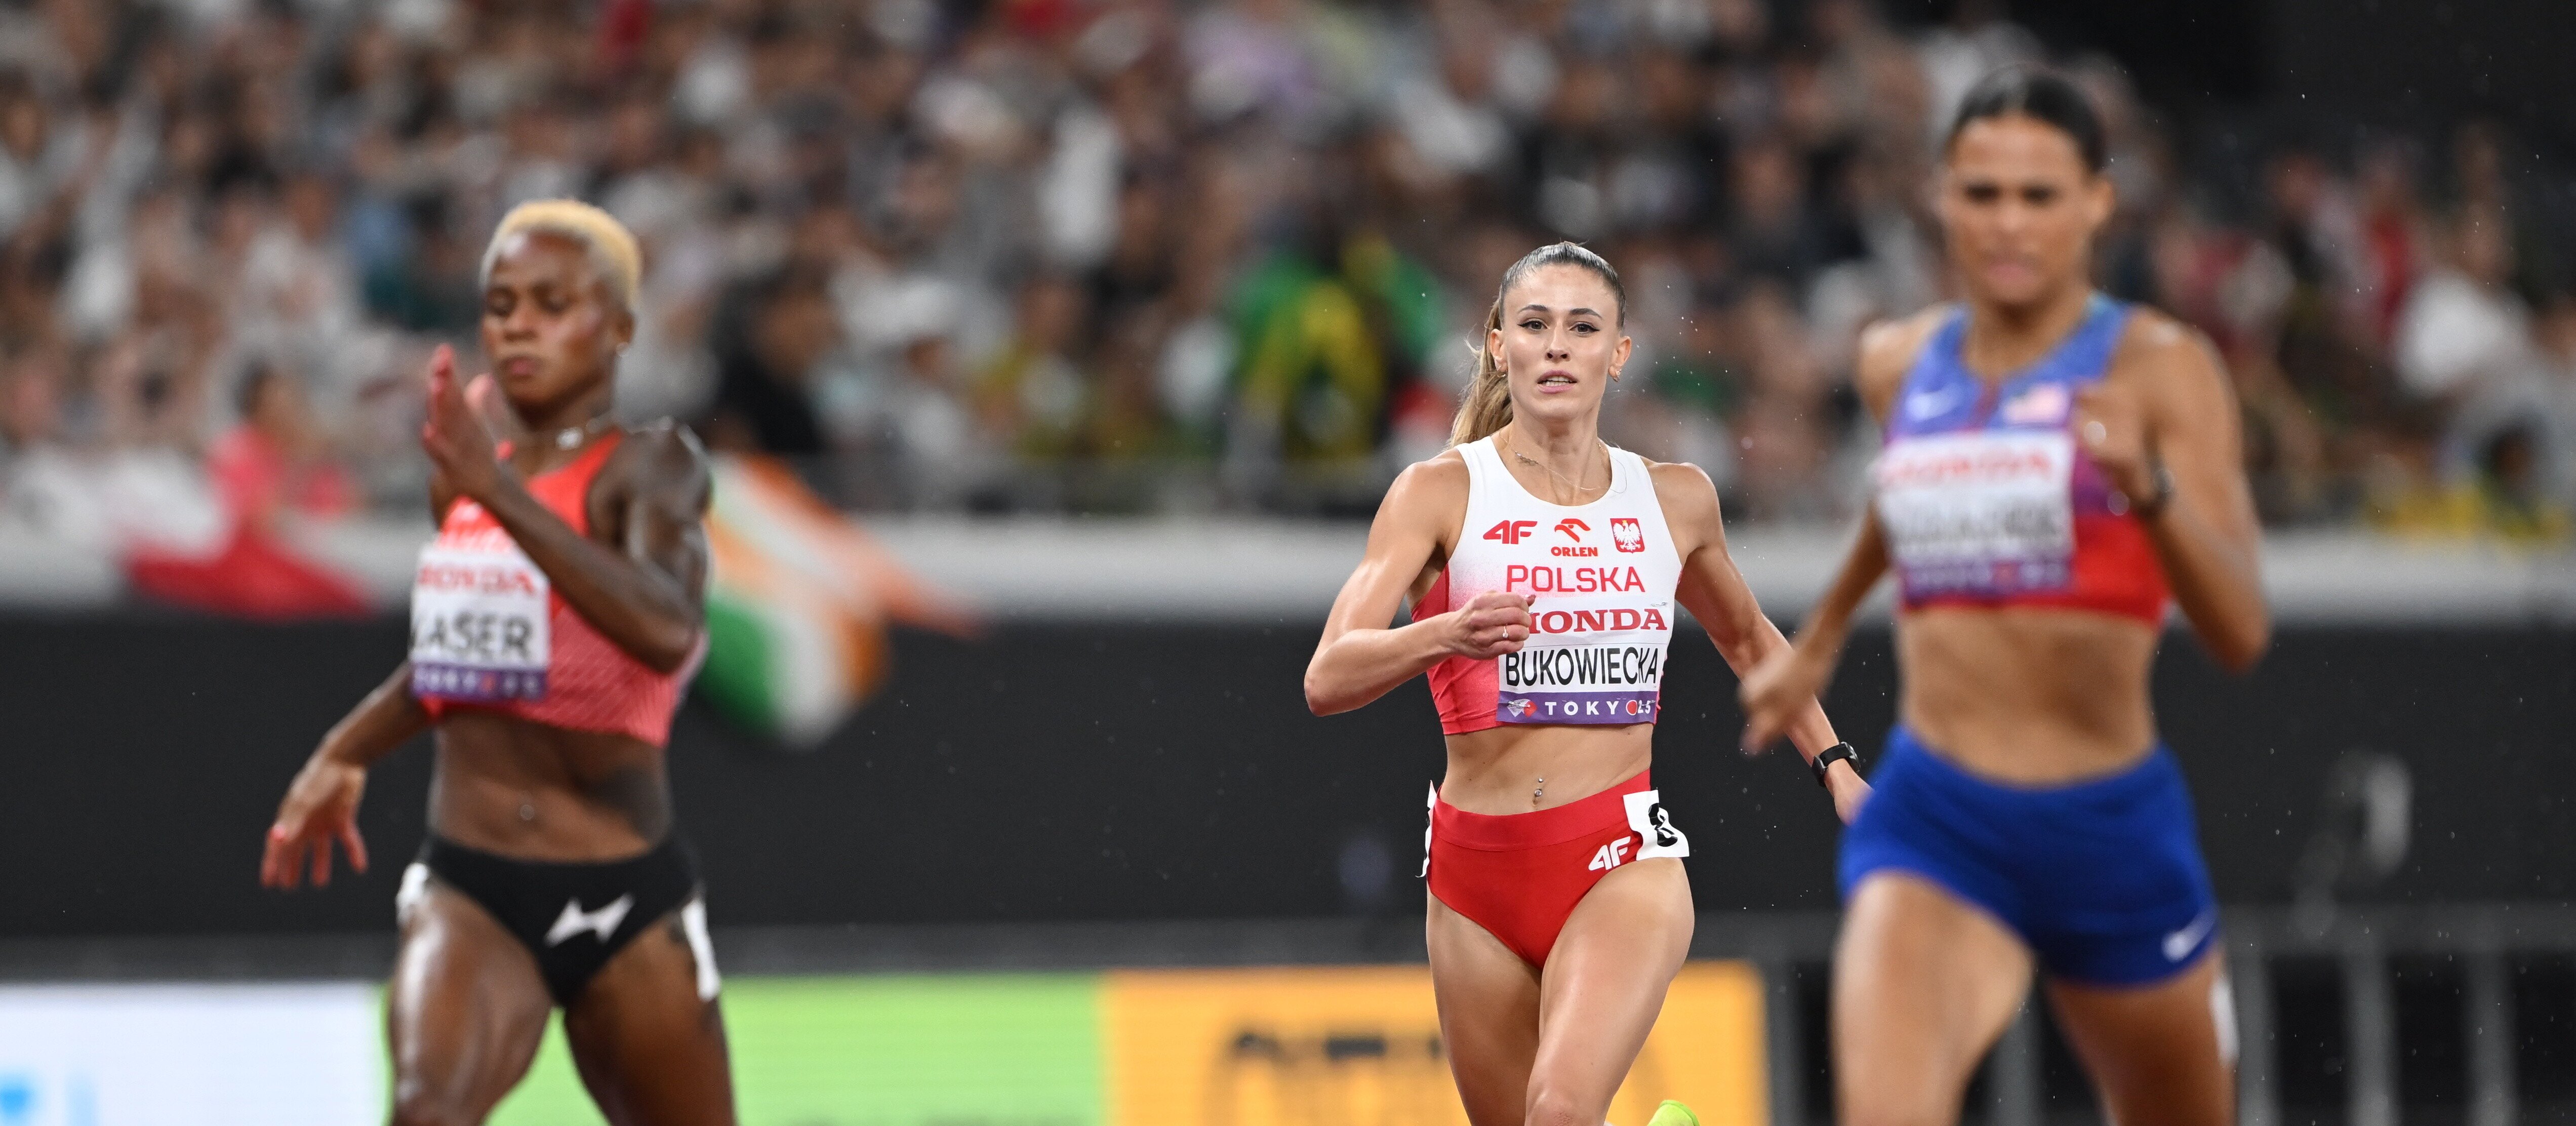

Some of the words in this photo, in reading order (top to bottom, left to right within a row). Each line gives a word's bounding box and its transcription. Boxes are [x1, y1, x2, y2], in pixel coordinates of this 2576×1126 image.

[1482, 519, 1538, 545] 4F
[1550, 546, 1599, 557] ORLEN
[1506, 564, 1645, 593] POLSKA
[1505, 646, 1659, 687] BUKOWIECKA
[1588, 835, 1631, 871] 4F
